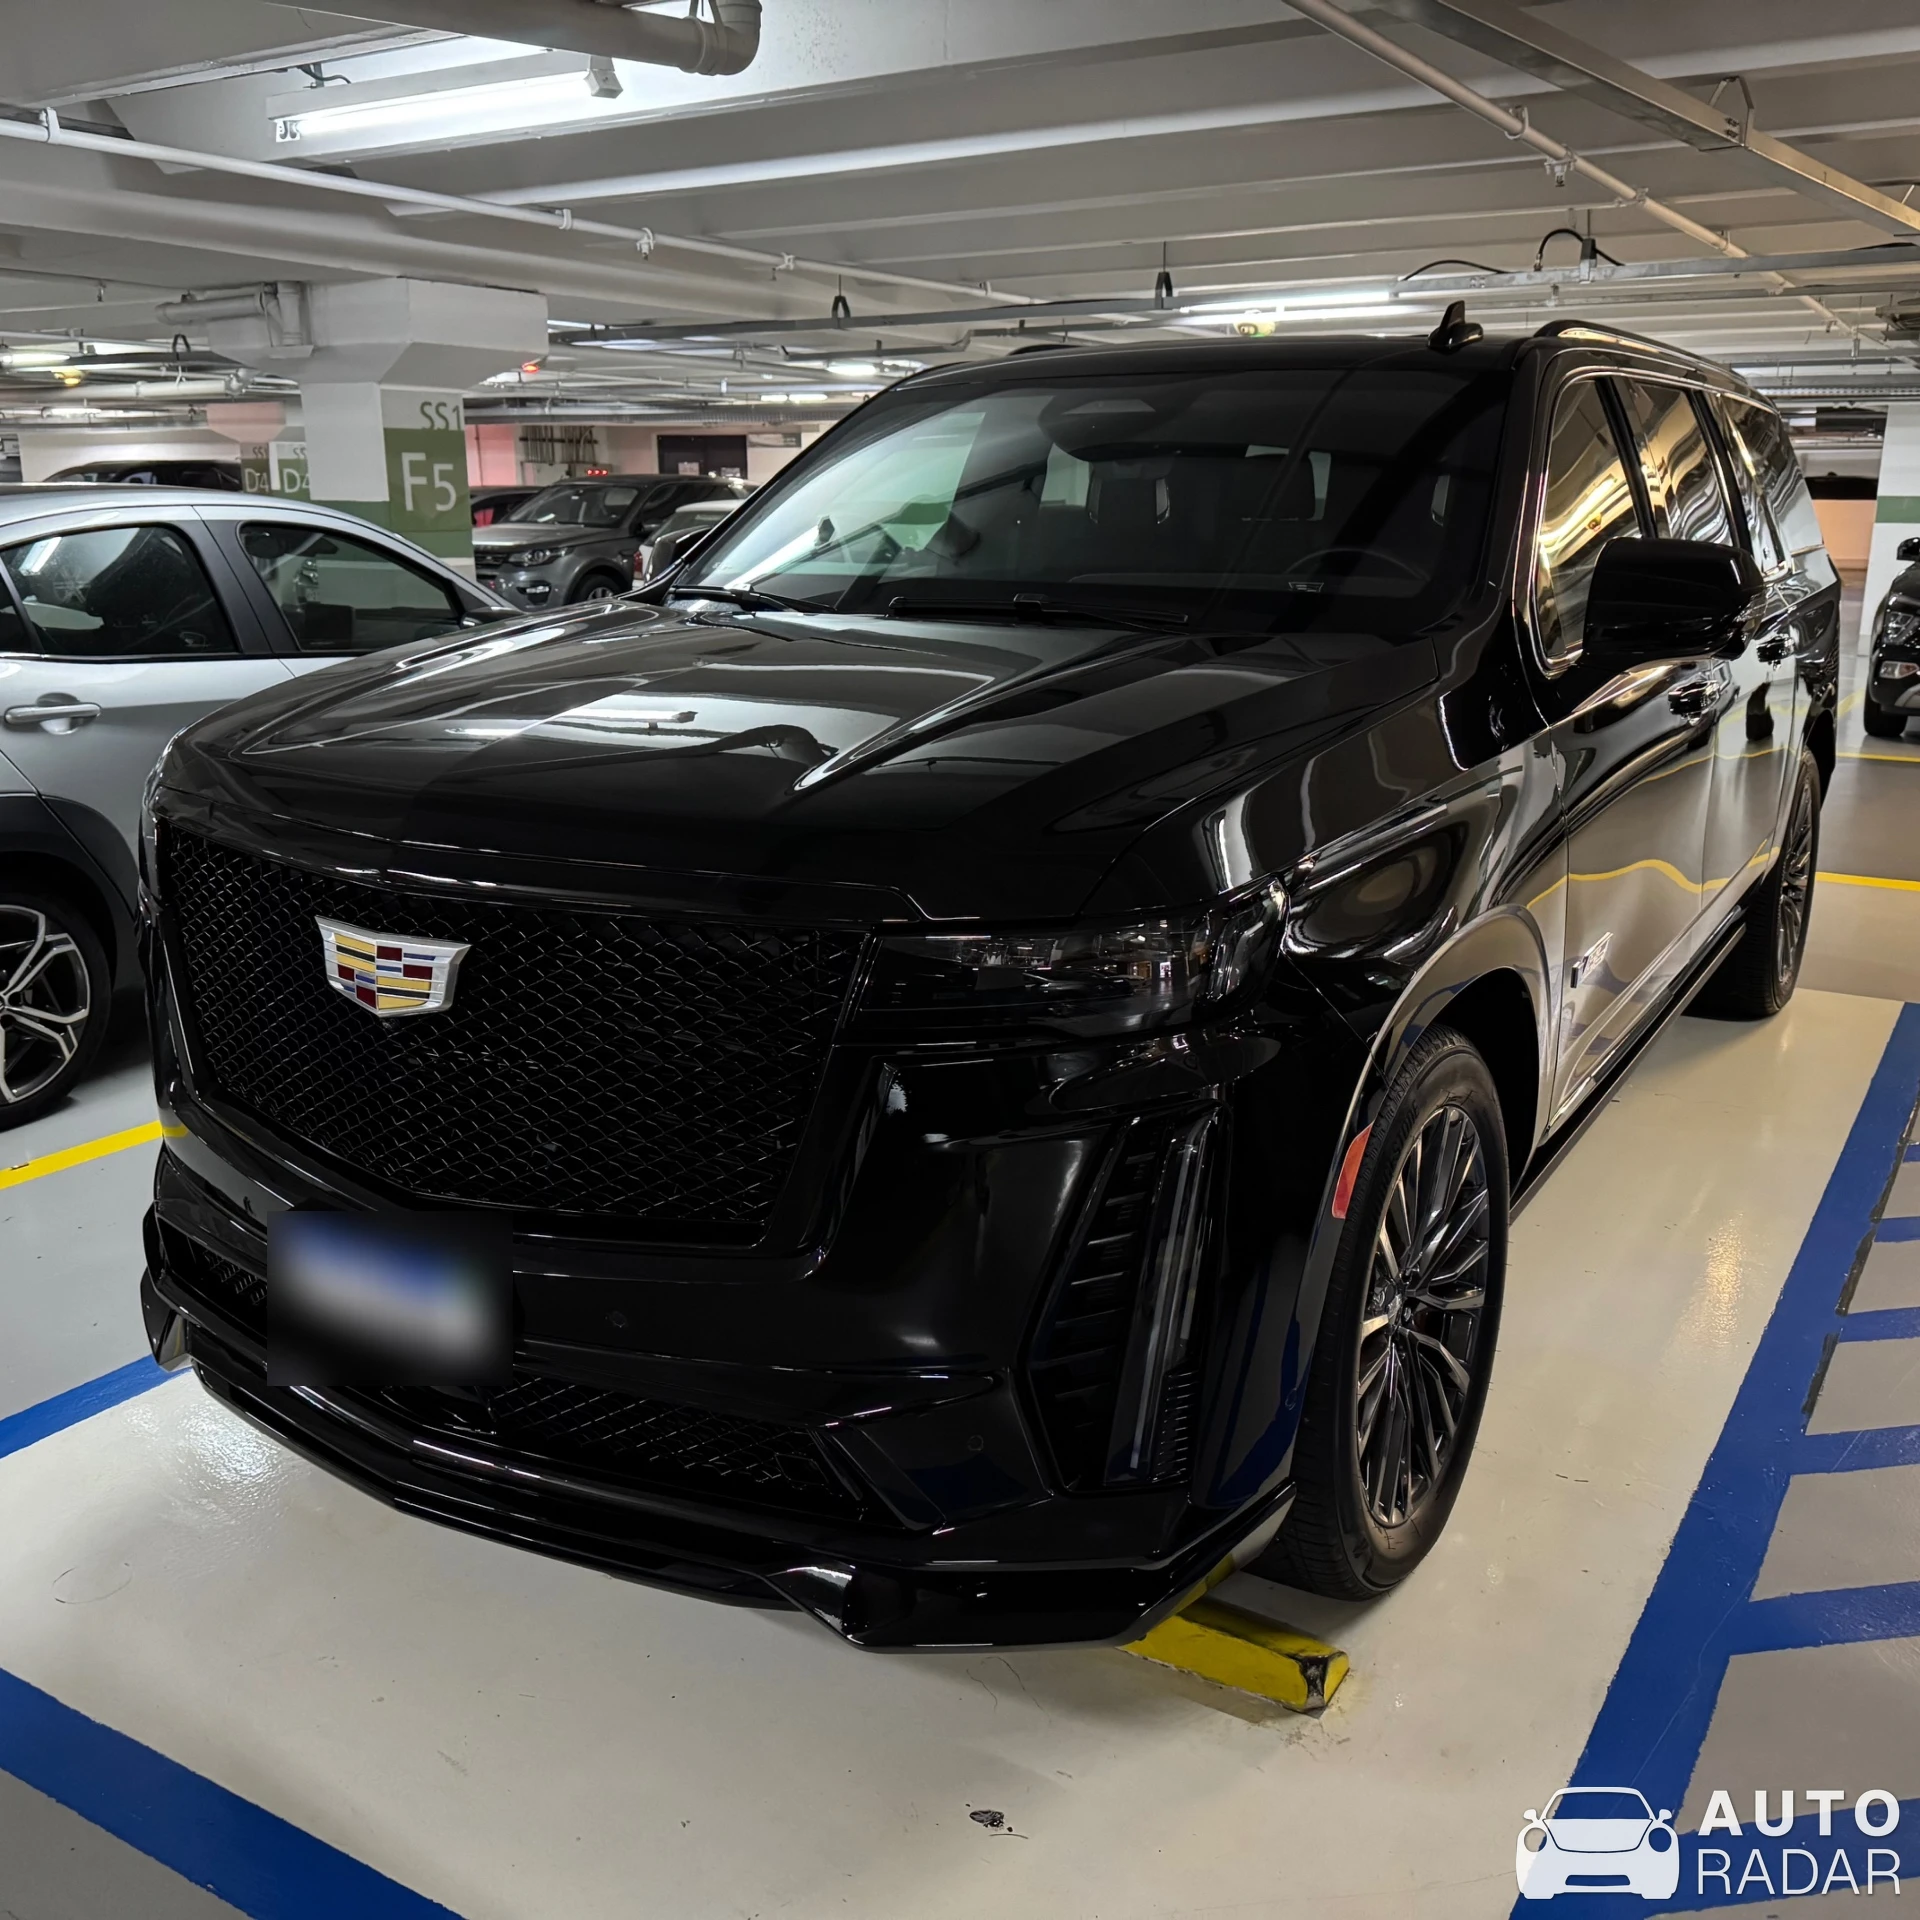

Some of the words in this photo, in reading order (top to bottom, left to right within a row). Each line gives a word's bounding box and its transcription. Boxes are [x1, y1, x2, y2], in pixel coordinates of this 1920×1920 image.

[420, 401, 461, 430] SS1
[244, 468, 270, 493] D4
[401, 451, 457, 511] F5
